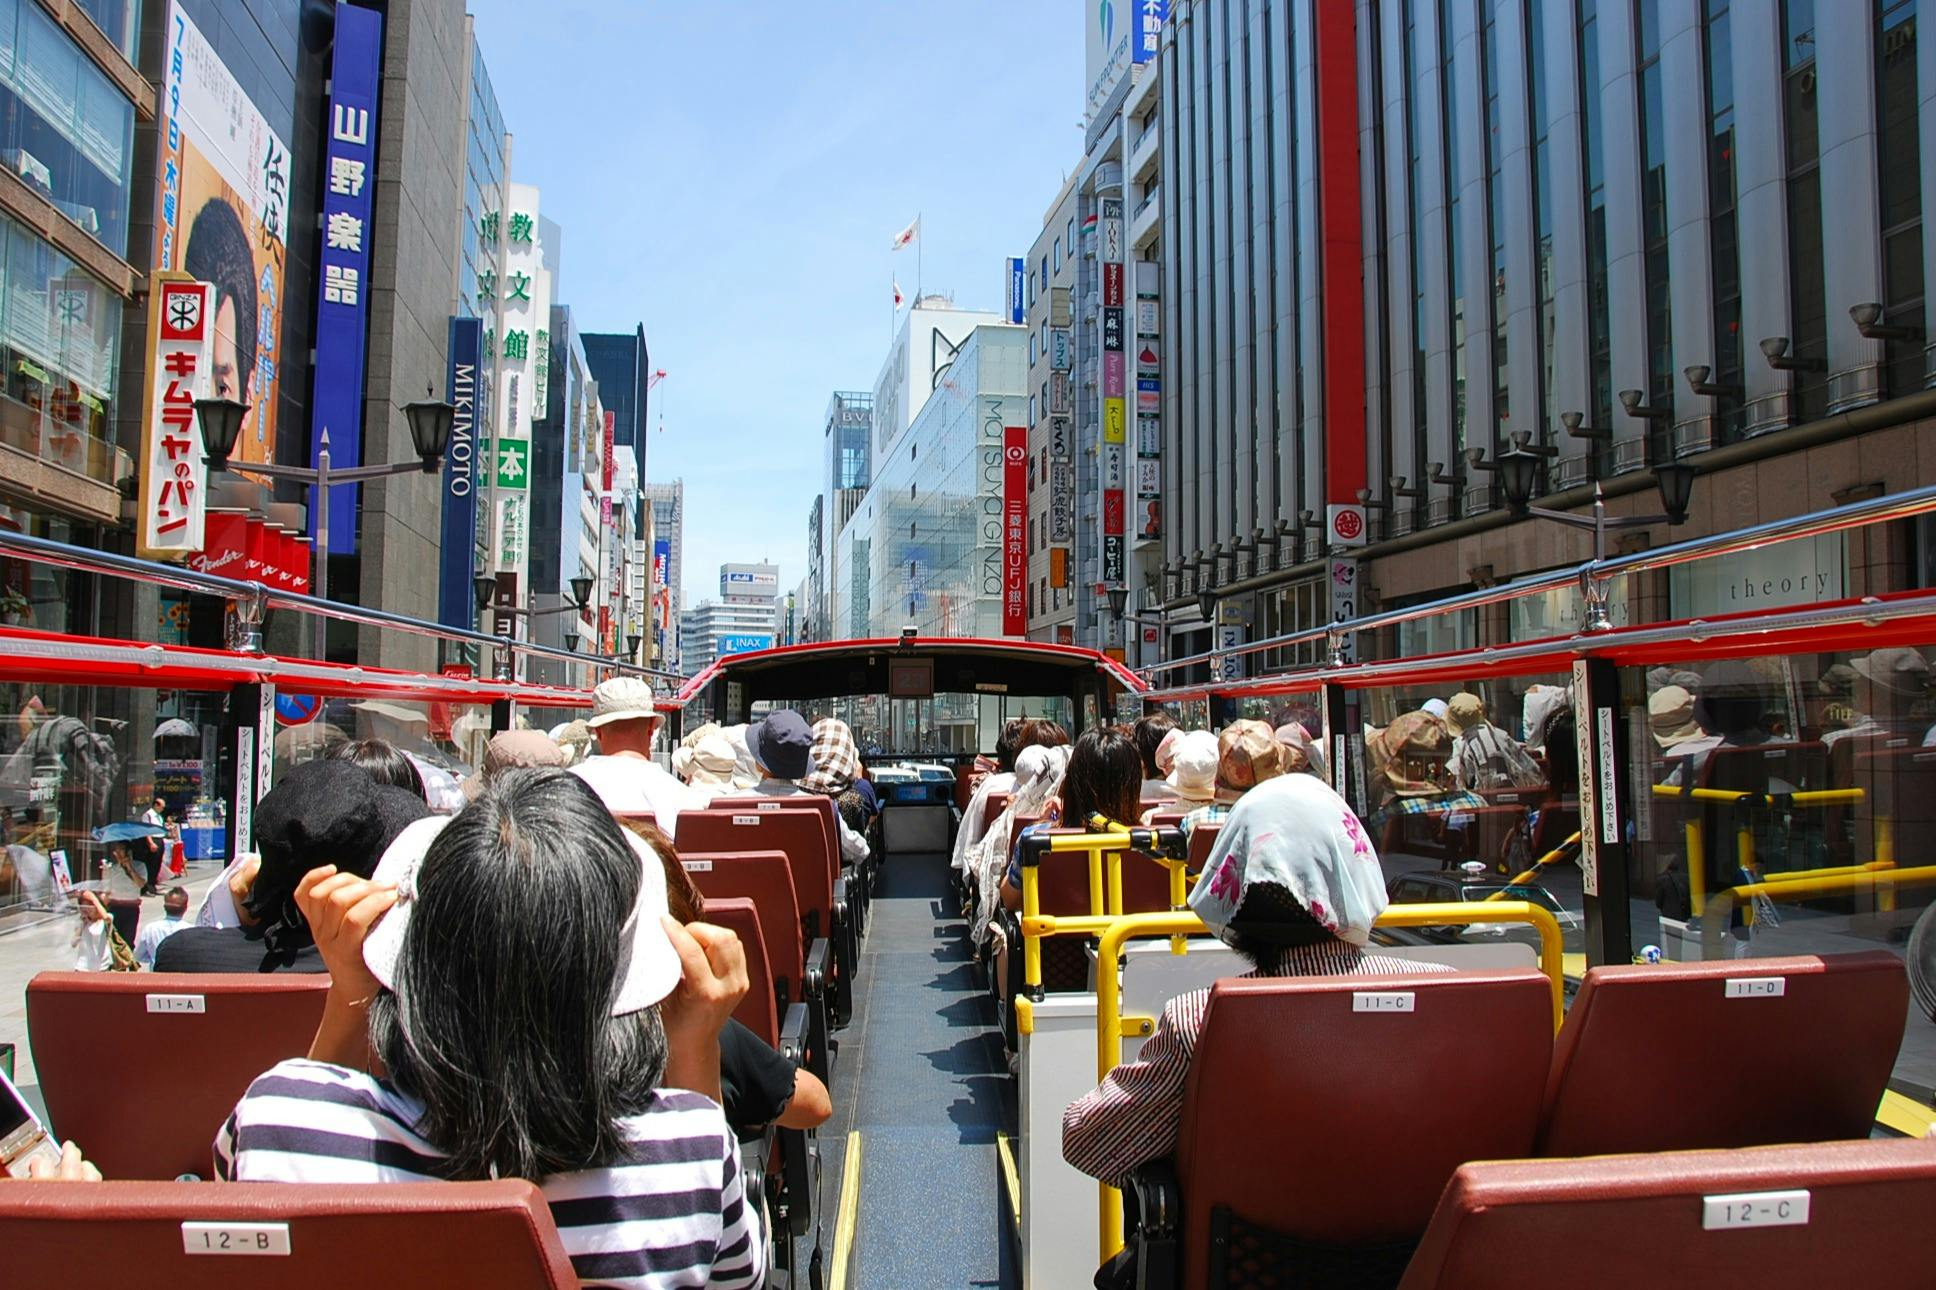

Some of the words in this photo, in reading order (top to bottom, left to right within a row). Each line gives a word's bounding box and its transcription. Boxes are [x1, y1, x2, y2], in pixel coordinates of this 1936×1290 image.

[323, 103, 369, 307] 山野楽器
[169, 294, 199, 302] GINZA
[502, 211, 534, 362] 教文館
[1055, 332, 1065, 367] トップス
[157, 351, 197, 536] キムラヤのパン
[451, 364, 475, 497] MIKIMOTO
[499, 447, 525, 481] 本
[502, 496, 517, 563] ナルニア国
[192, 549, 244, 573] Fender
[1008, 500, 1022, 617] 三菱東京UFJ銀行
[1730, 571, 1828, 601] theory
[1560, 602, 1628, 623] thry
[736, 638, 761, 648] INAX
[239, 728, 250, 853] シートベルトをおしめ下
[1364, 997, 1404, 1008] 11-C
[1736, 981, 1776, 994] 11-D
[156, 998, 194, 1010] 11-A
[1724, 1201, 1790, 1222] 12-C
[203, 1231, 269, 1250] 12-B
